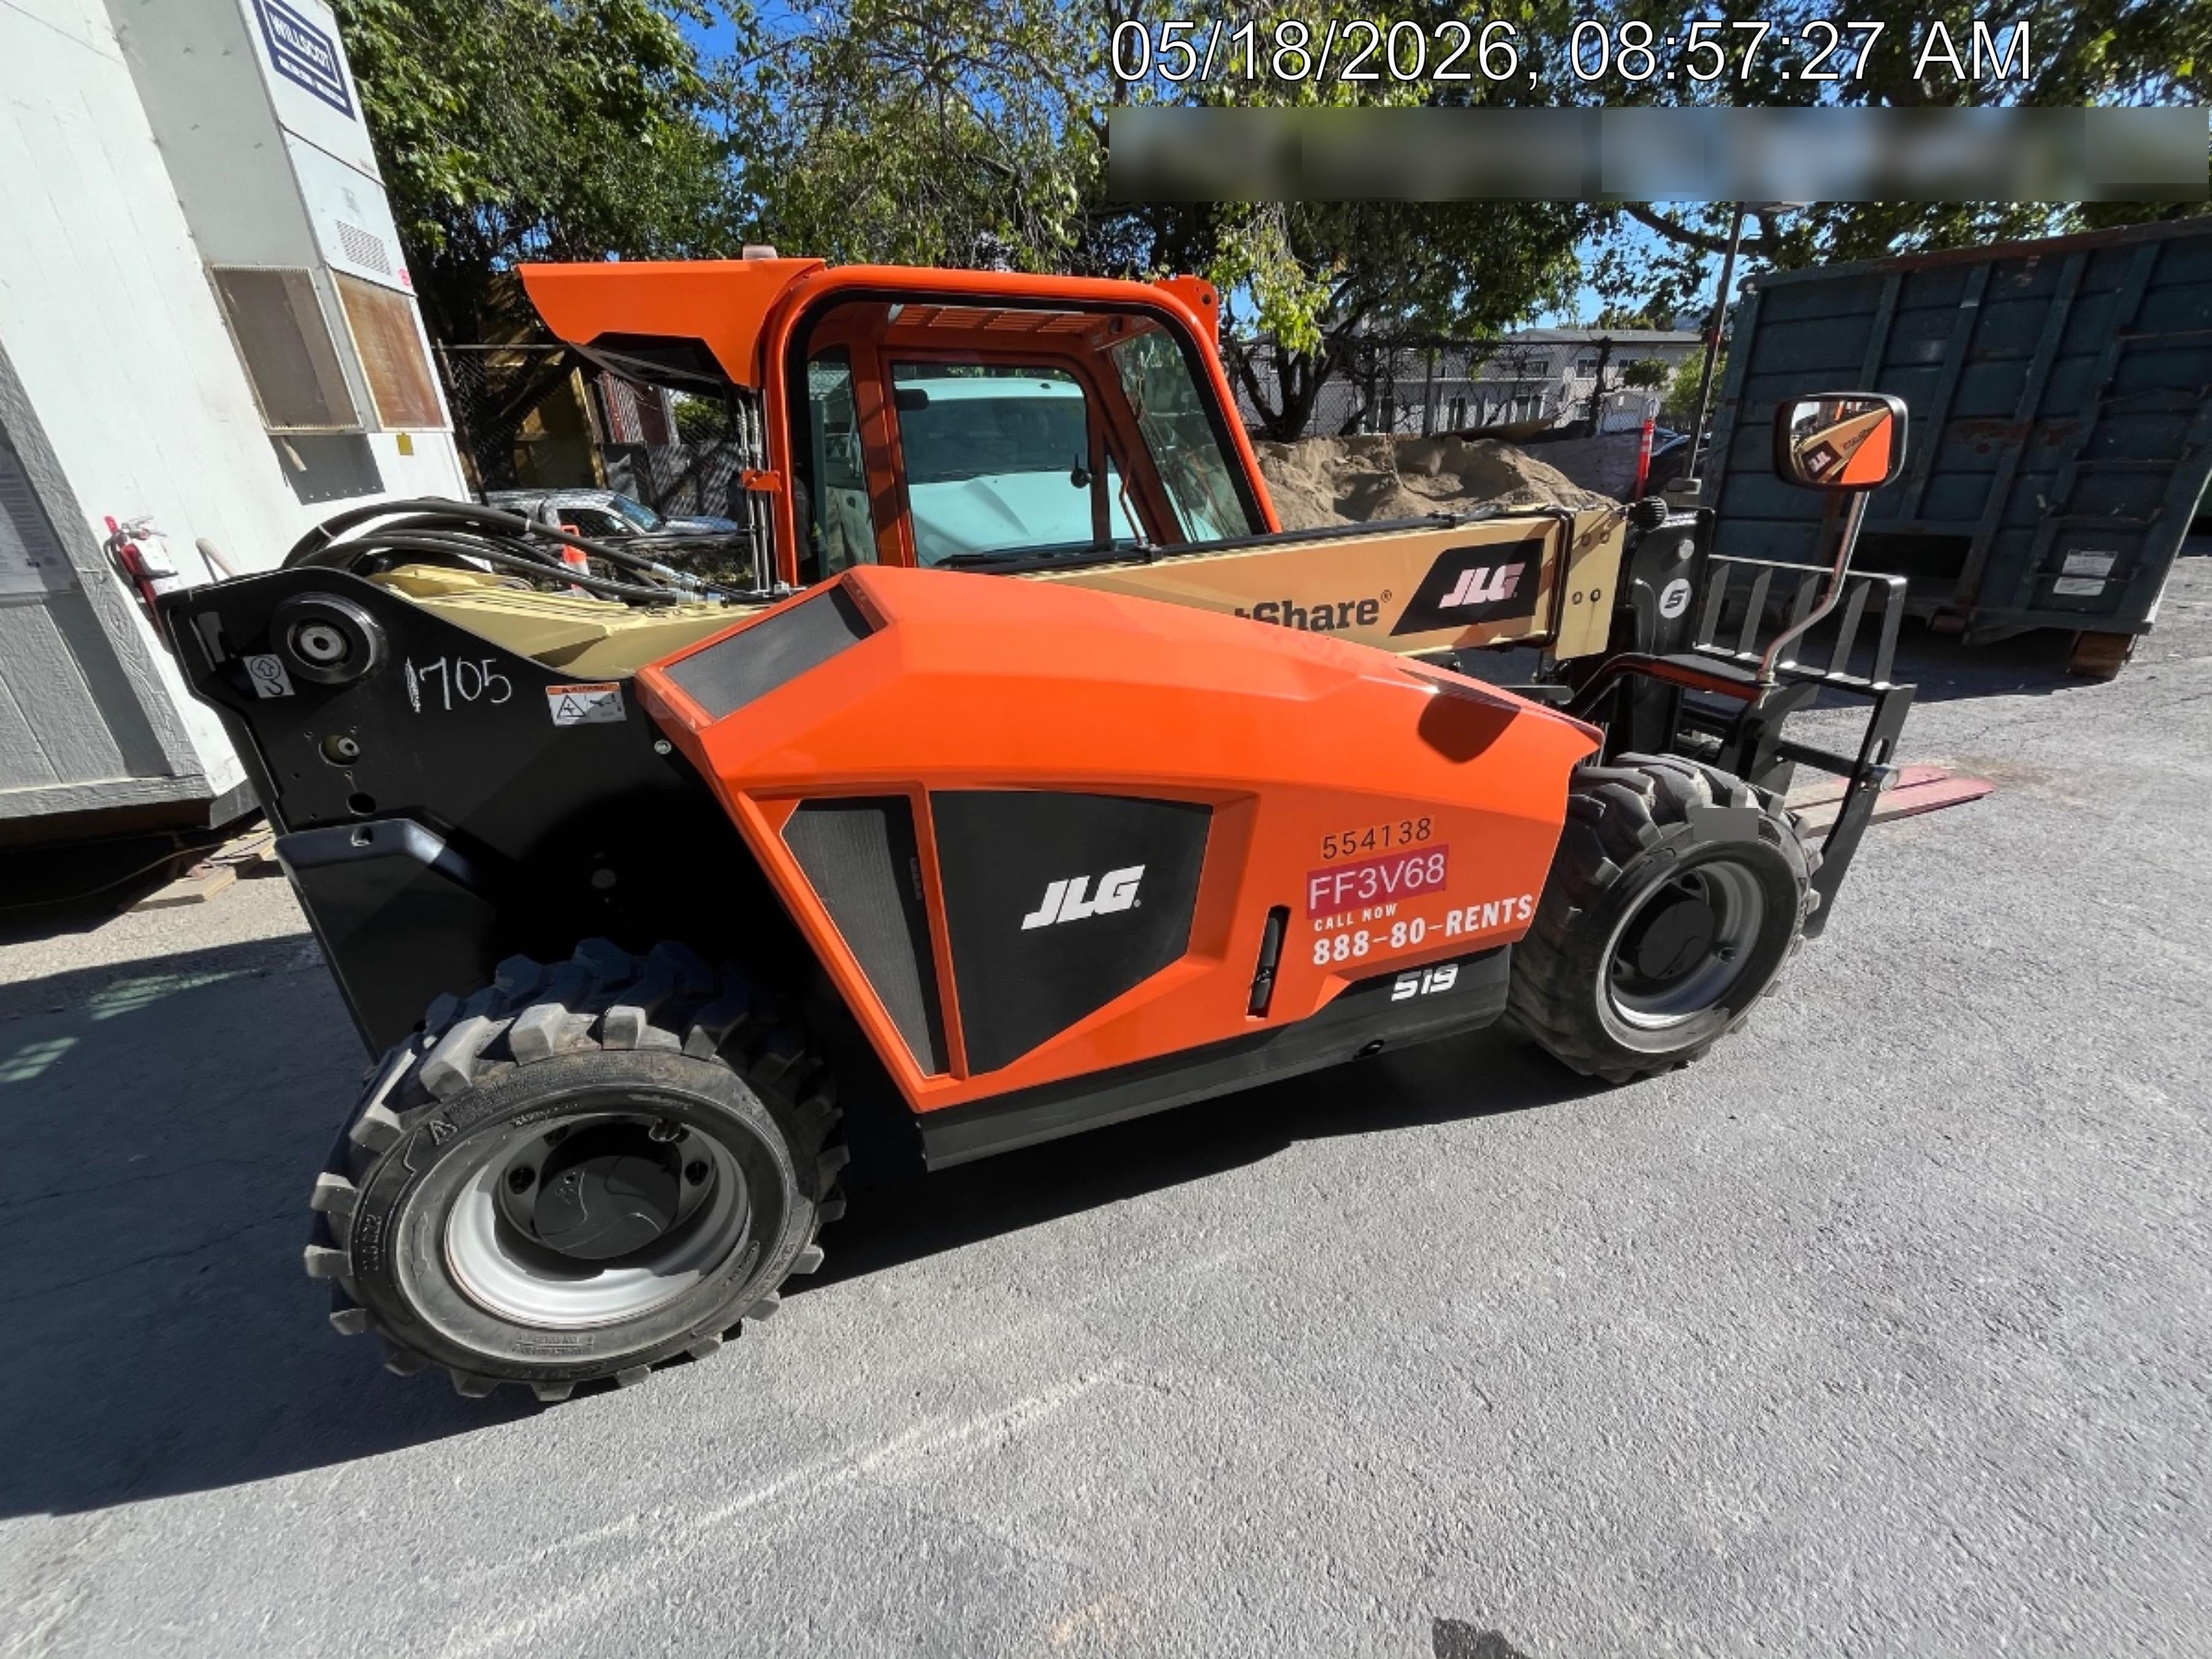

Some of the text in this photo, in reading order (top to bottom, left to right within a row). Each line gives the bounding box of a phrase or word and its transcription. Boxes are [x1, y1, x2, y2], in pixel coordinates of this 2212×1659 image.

[1438, 562, 1526, 610] JLG
[405, 656, 512, 714] 1705
[1323, 817, 1431, 860] 554138
[1021, 864, 1145, 930] JLG
[1309, 852, 1445, 910] FF3V68
[1312, 893, 1533, 965] 888-80-RENTS
[1314, 903, 1397, 931] CALL NOW
[1390, 963, 1459, 1002] 519
